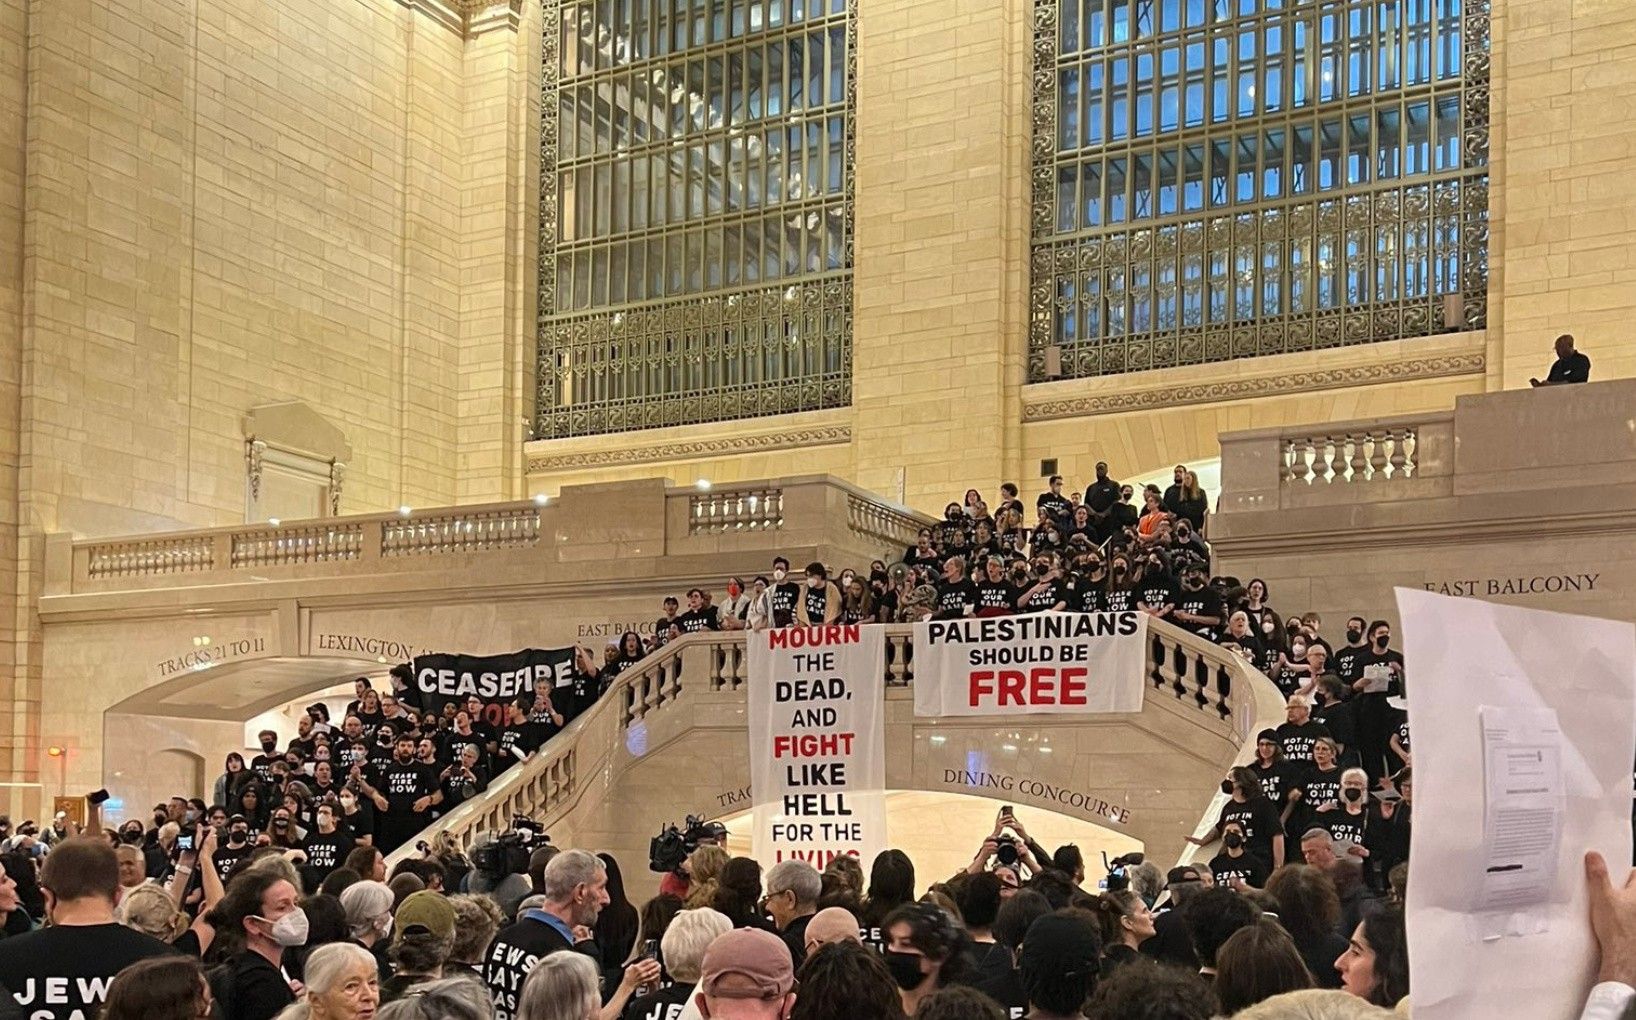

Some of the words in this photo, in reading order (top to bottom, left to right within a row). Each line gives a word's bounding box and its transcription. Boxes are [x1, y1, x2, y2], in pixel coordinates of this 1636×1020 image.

[1487, 574, 1600, 595] BALCONY
[578, 623, 610, 637] EAST
[769, 623, 860, 650] MOURN
[928, 612, 1138, 645] PALESTINIANS
[159, 648, 212, 676] TRACKS
[215, 645, 227, 660] 21
[230, 638, 251, 656] TO
[320, 634, 414, 660] LEXINGTON
[969, 646, 1054, 666] SHOULD
[1059, 643, 1089, 662] BE
[792, 652, 835, 673] THE
[775, 678, 852, 702] DEAD,
[969, 667, 1088, 706] FREE
[791, 707, 837, 728] AND
[774, 733, 855, 758] FIGHT
[1283, 737, 1302, 745] NOT
[1304, 737, 1315, 745] IN
[1286, 744, 1309, 752] OUR
[787, 763, 846, 786] LIKE
[1307, 782, 1326, 790] NOT
[1329, 782, 1340, 790] IN
[389, 784, 417, 794] NOW
[944, 769, 1014, 791] DINING
[1019, 779, 1131, 824] CONCOURSE
[784, 793, 852, 816] HELL
[772, 823, 813, 842] FOR
[819, 823, 862, 841] THE
[1331, 824, 1354, 833] NOT
